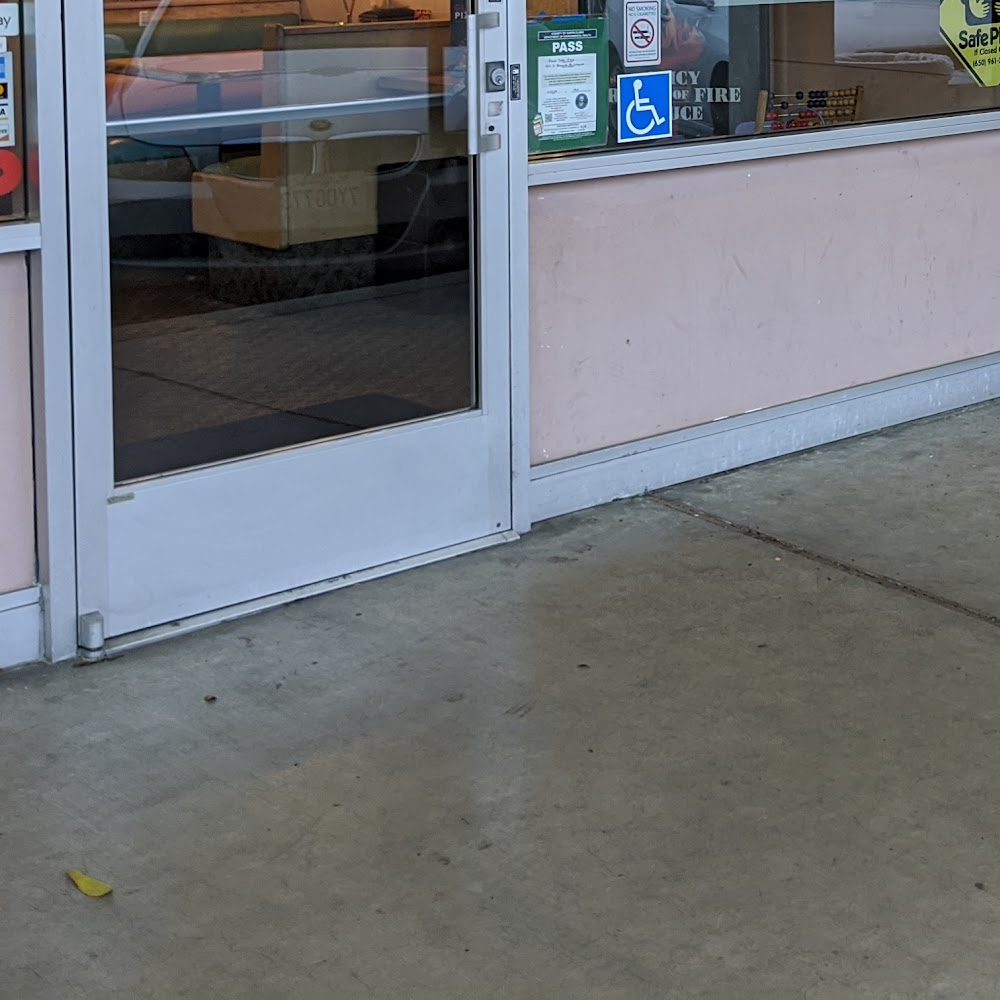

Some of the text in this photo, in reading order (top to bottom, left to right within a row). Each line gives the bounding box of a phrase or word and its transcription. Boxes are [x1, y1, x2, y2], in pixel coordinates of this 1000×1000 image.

[959, 29, 988, 49] Safe
[552, 41, 583, 53] PASS
[980, 46, 997, 55] Closed
[671, 70, 701, 85] ICY
[672, 87, 741, 102] OF FIRE
[671, 106, 703, 121] UCE
